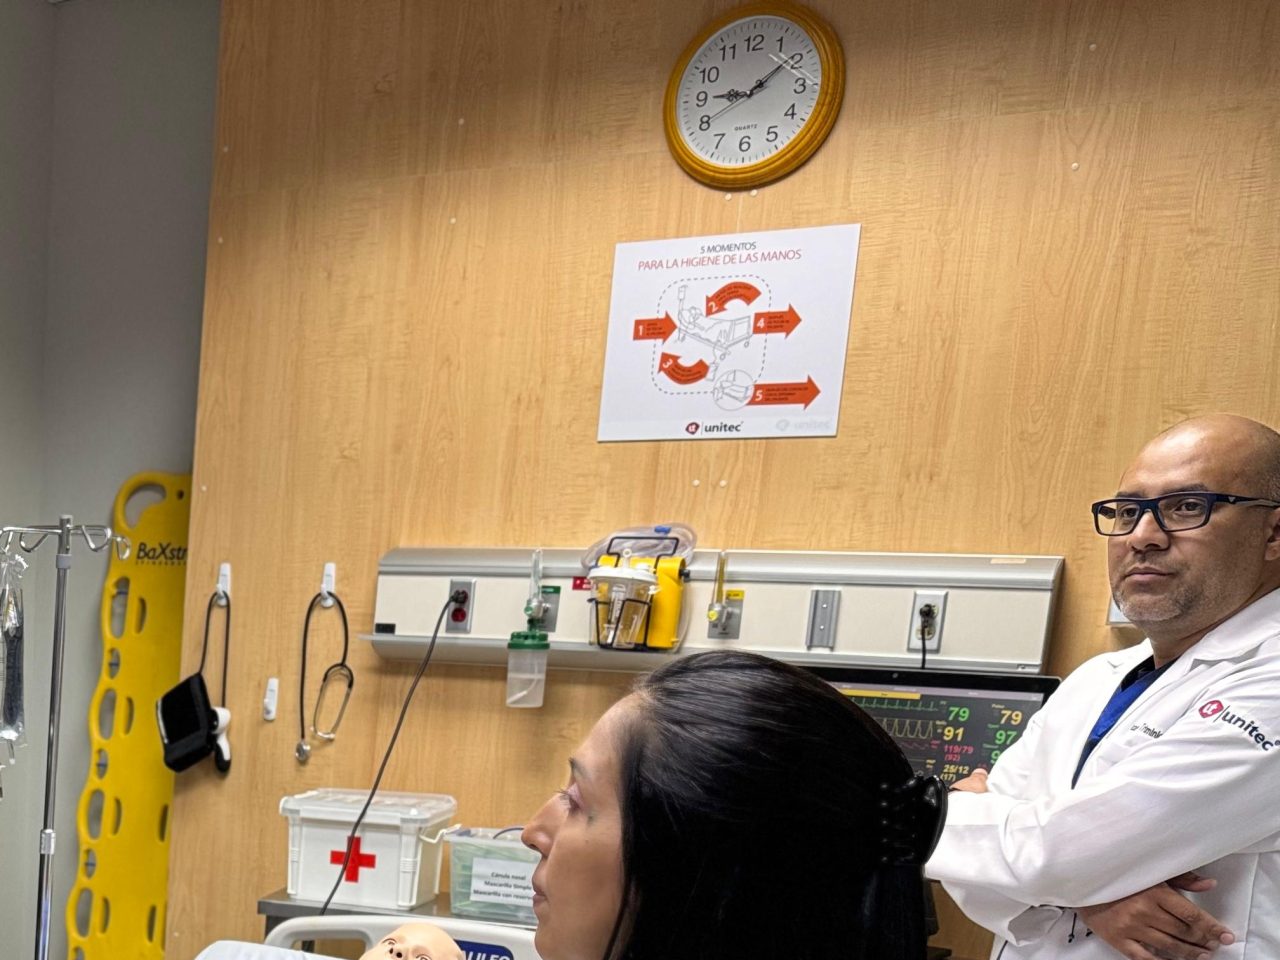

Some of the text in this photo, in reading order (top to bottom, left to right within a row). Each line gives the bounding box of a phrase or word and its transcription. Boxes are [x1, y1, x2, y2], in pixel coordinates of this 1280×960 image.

[744, 34, 765, 52] 12
[776, 36, 784, 52] 1
[720, 43, 736, 61] 11
[790, 53, 803, 69] 2
[699, 66, 719, 84] 10
[793, 77, 806, 94] 3
[696, 91, 708, 108] 9
[784, 103, 797, 120] 4
[699, 115, 711, 131] 8
[734, 124, 758, 132] QUARTZ
[713, 133, 726, 149] 7
[766, 125, 779, 143] 5
[738, 136, 751, 152] 6
[700, 241, 757, 255] 5 MOMENTOS
[638, 249, 802, 271] PARA LA HIGIENE DE LAS MANOS
[707, 302, 719, 313] 2
[638, 325, 644, 336] 1
[757, 318, 765, 329] 4
[662, 358, 673, 369] 3
[755, 390, 763, 401] 5
[704, 422, 741, 433] unitec
[136, 542, 188, 560] BaXstr
[948, 707, 969, 722] 79
[1000, 710, 1023, 726] 79
[943, 726, 964, 742] 91
[995, 730, 1017, 745] 97
[991, 751, 1002, 766] 9
